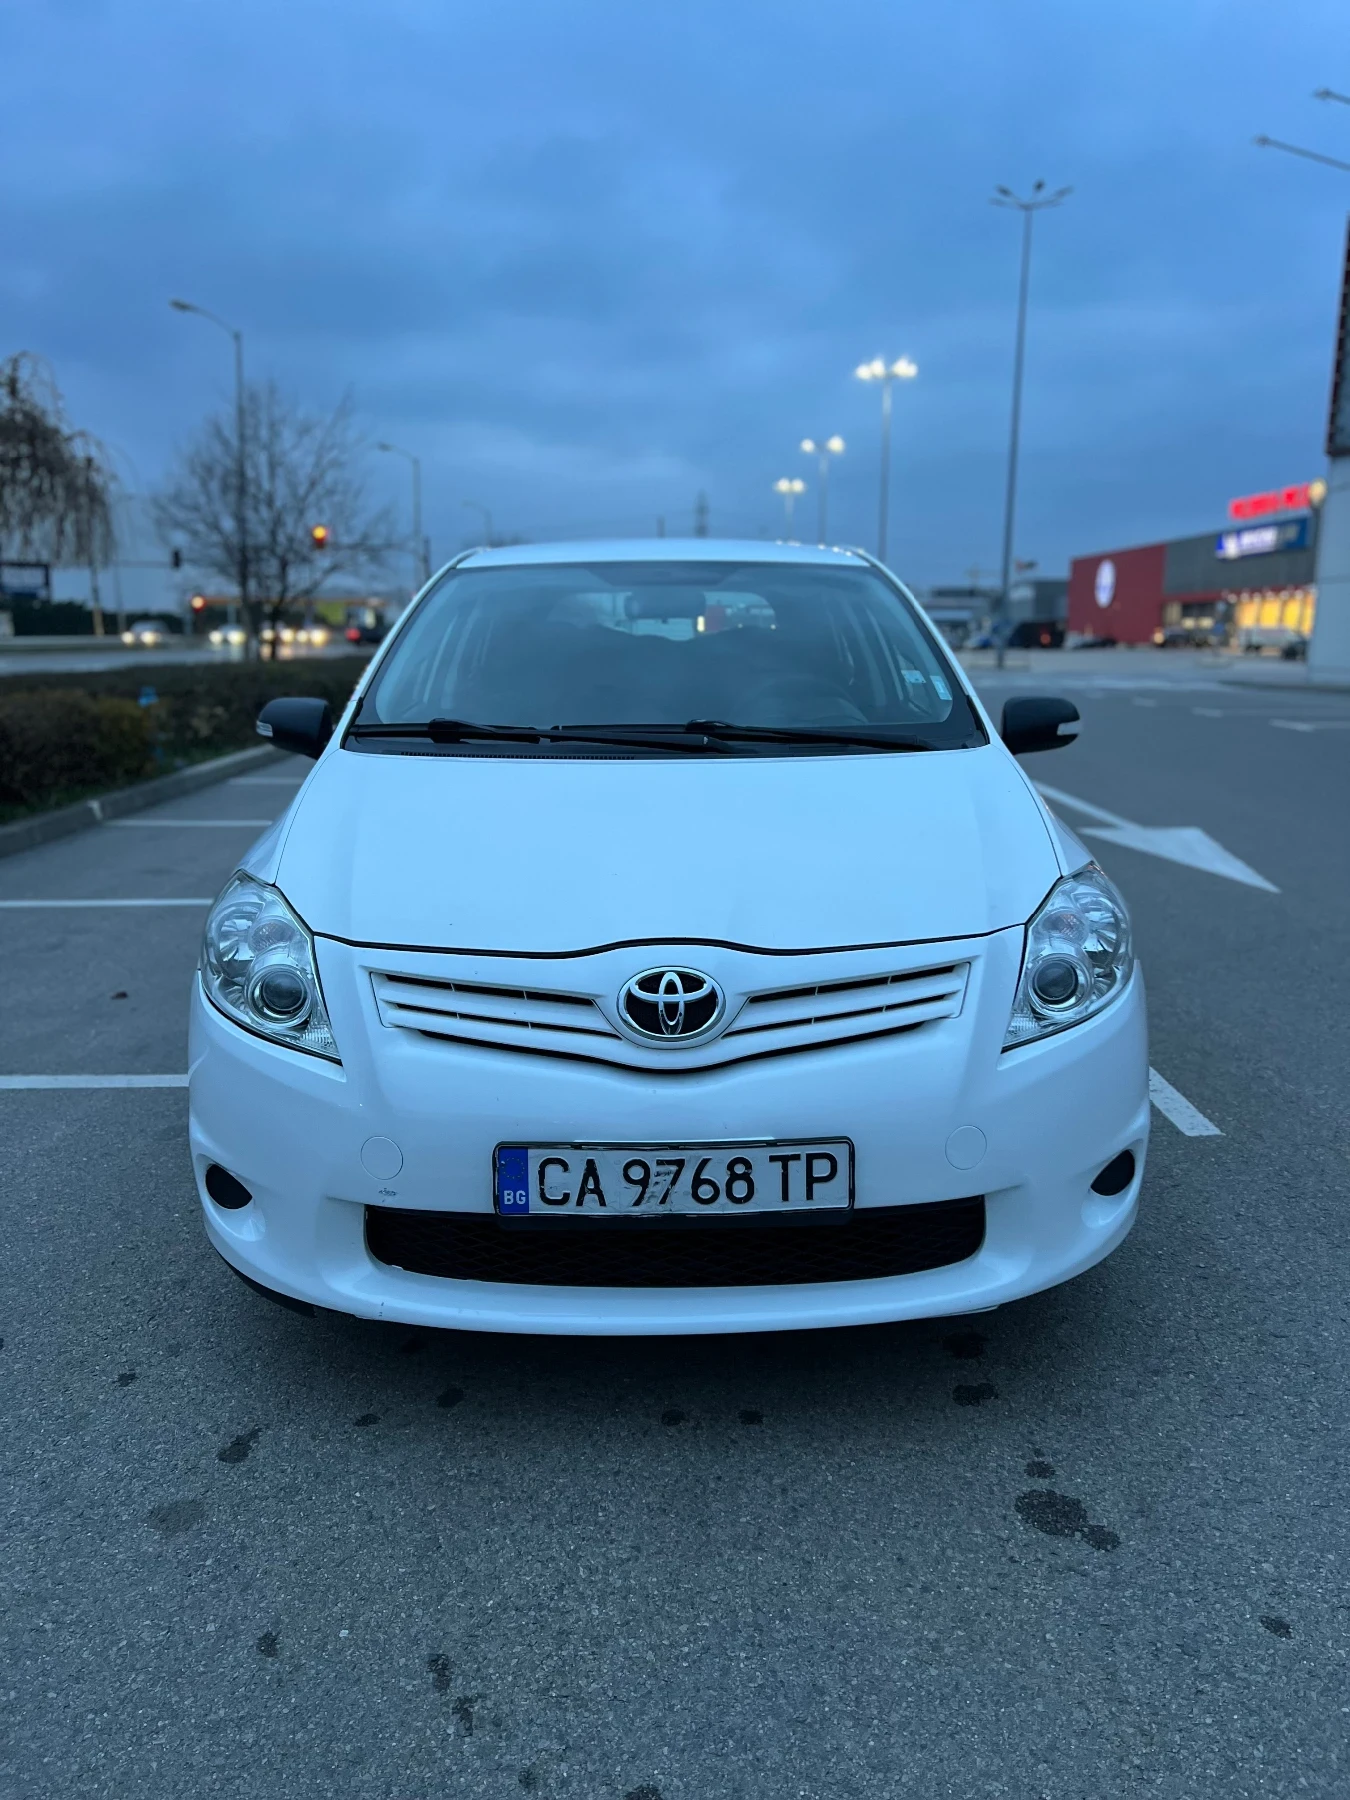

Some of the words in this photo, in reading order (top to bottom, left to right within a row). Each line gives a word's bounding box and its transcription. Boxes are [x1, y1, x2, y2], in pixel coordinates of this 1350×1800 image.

[537, 1157, 607, 1207] CA
[622, 1156, 756, 1206] 9768
[768, 1152, 838, 1202] TP
[503, 1190, 526, 1205] BG
